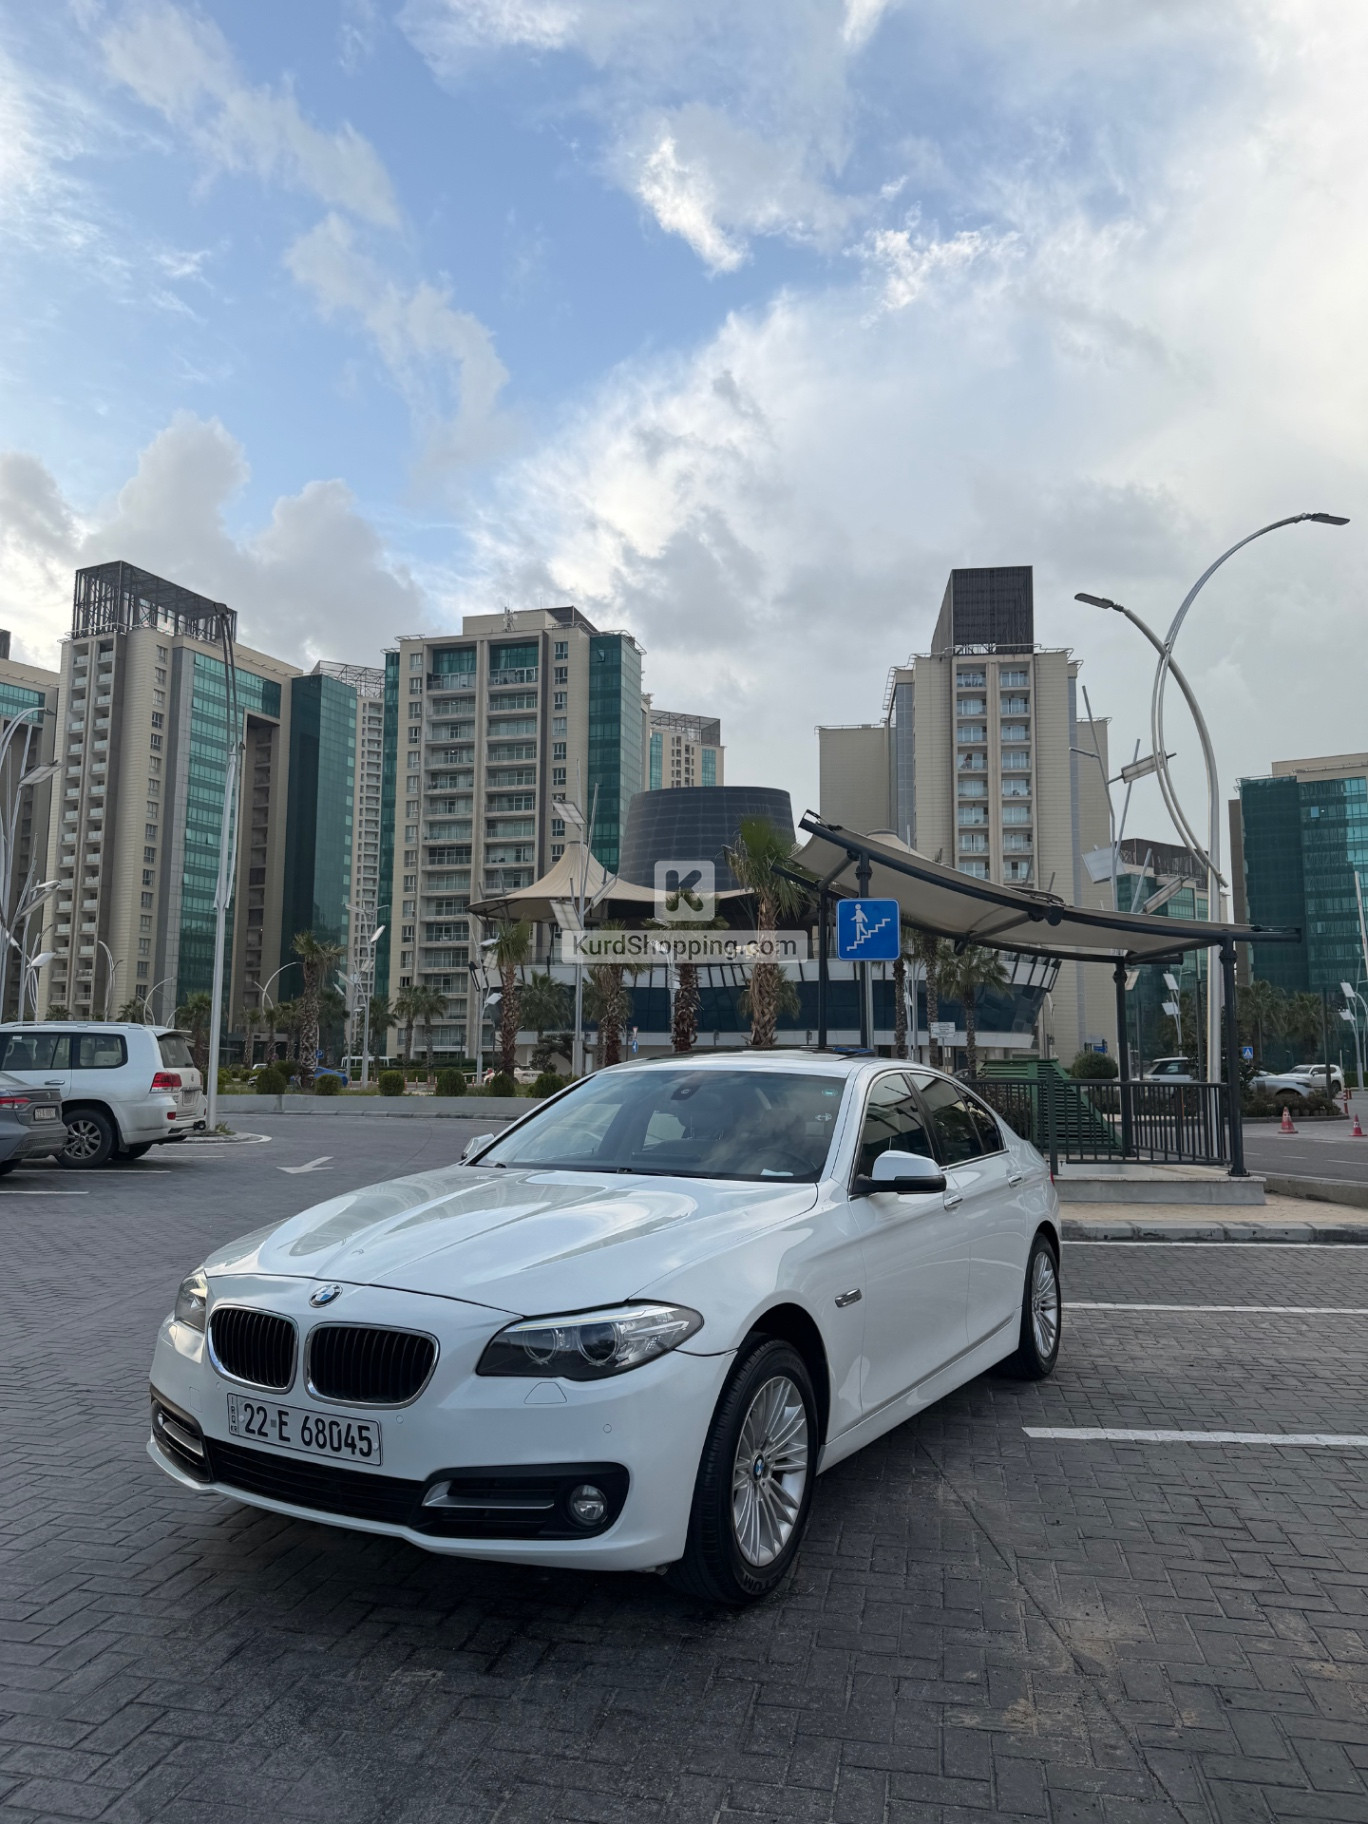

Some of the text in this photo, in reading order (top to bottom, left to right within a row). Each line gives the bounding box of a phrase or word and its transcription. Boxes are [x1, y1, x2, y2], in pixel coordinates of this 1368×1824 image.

[243, 1403, 372, 1457] 22 E 68045
